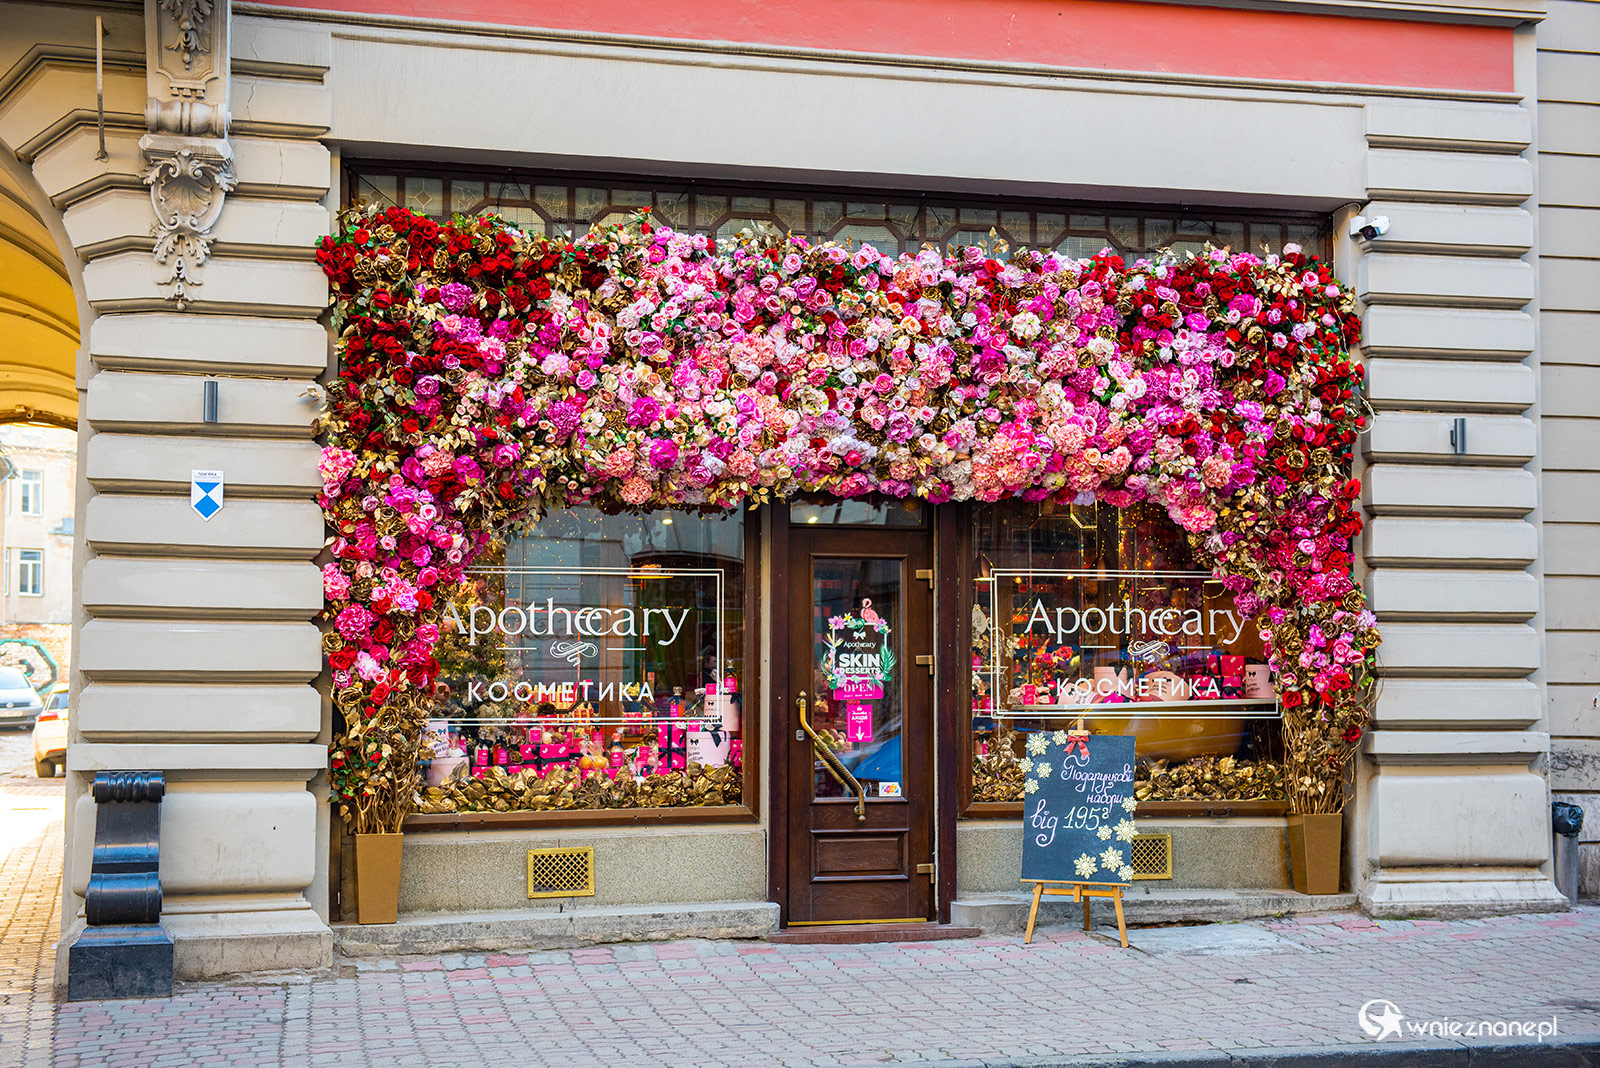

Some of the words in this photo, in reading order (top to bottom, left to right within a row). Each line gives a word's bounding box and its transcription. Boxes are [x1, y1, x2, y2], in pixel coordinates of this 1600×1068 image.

[441, 597, 690, 646] Apothecary
[1024, 598, 1246, 645] Apothecary
[839, 653, 880, 667] SKIN
[467, 681, 656, 702] КОСМЕТИКА
[843, 683, 873, 693] OPEN
[1056, 677, 1222, 698] КОСМЕТИКА
[1061, 754, 1133, 793] Подарункові
[1086, 782, 1124, 812] набори
[1030, 798, 1059, 847] від
